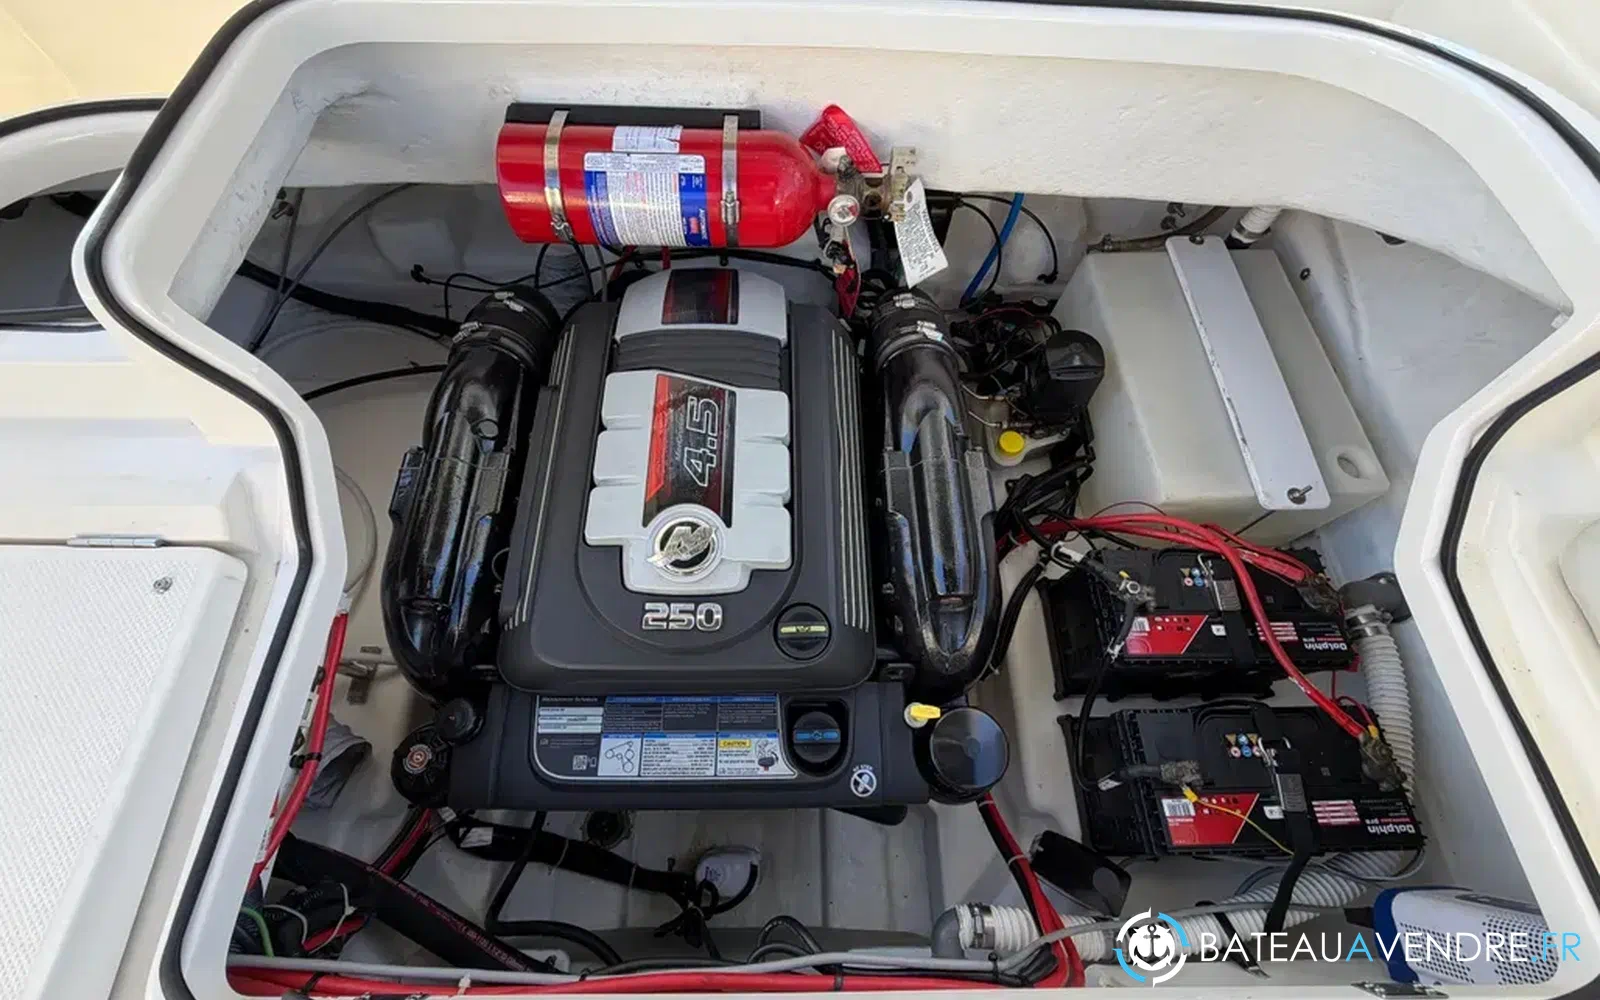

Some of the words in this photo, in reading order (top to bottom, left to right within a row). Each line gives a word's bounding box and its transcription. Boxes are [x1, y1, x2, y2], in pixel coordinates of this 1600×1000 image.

[683, 395, 720, 488] 4.5
[642, 601, 723, 632] 250
[1303, 642, 1349, 652] Dolphin
[1366, 824, 1417, 835] Dolphin
